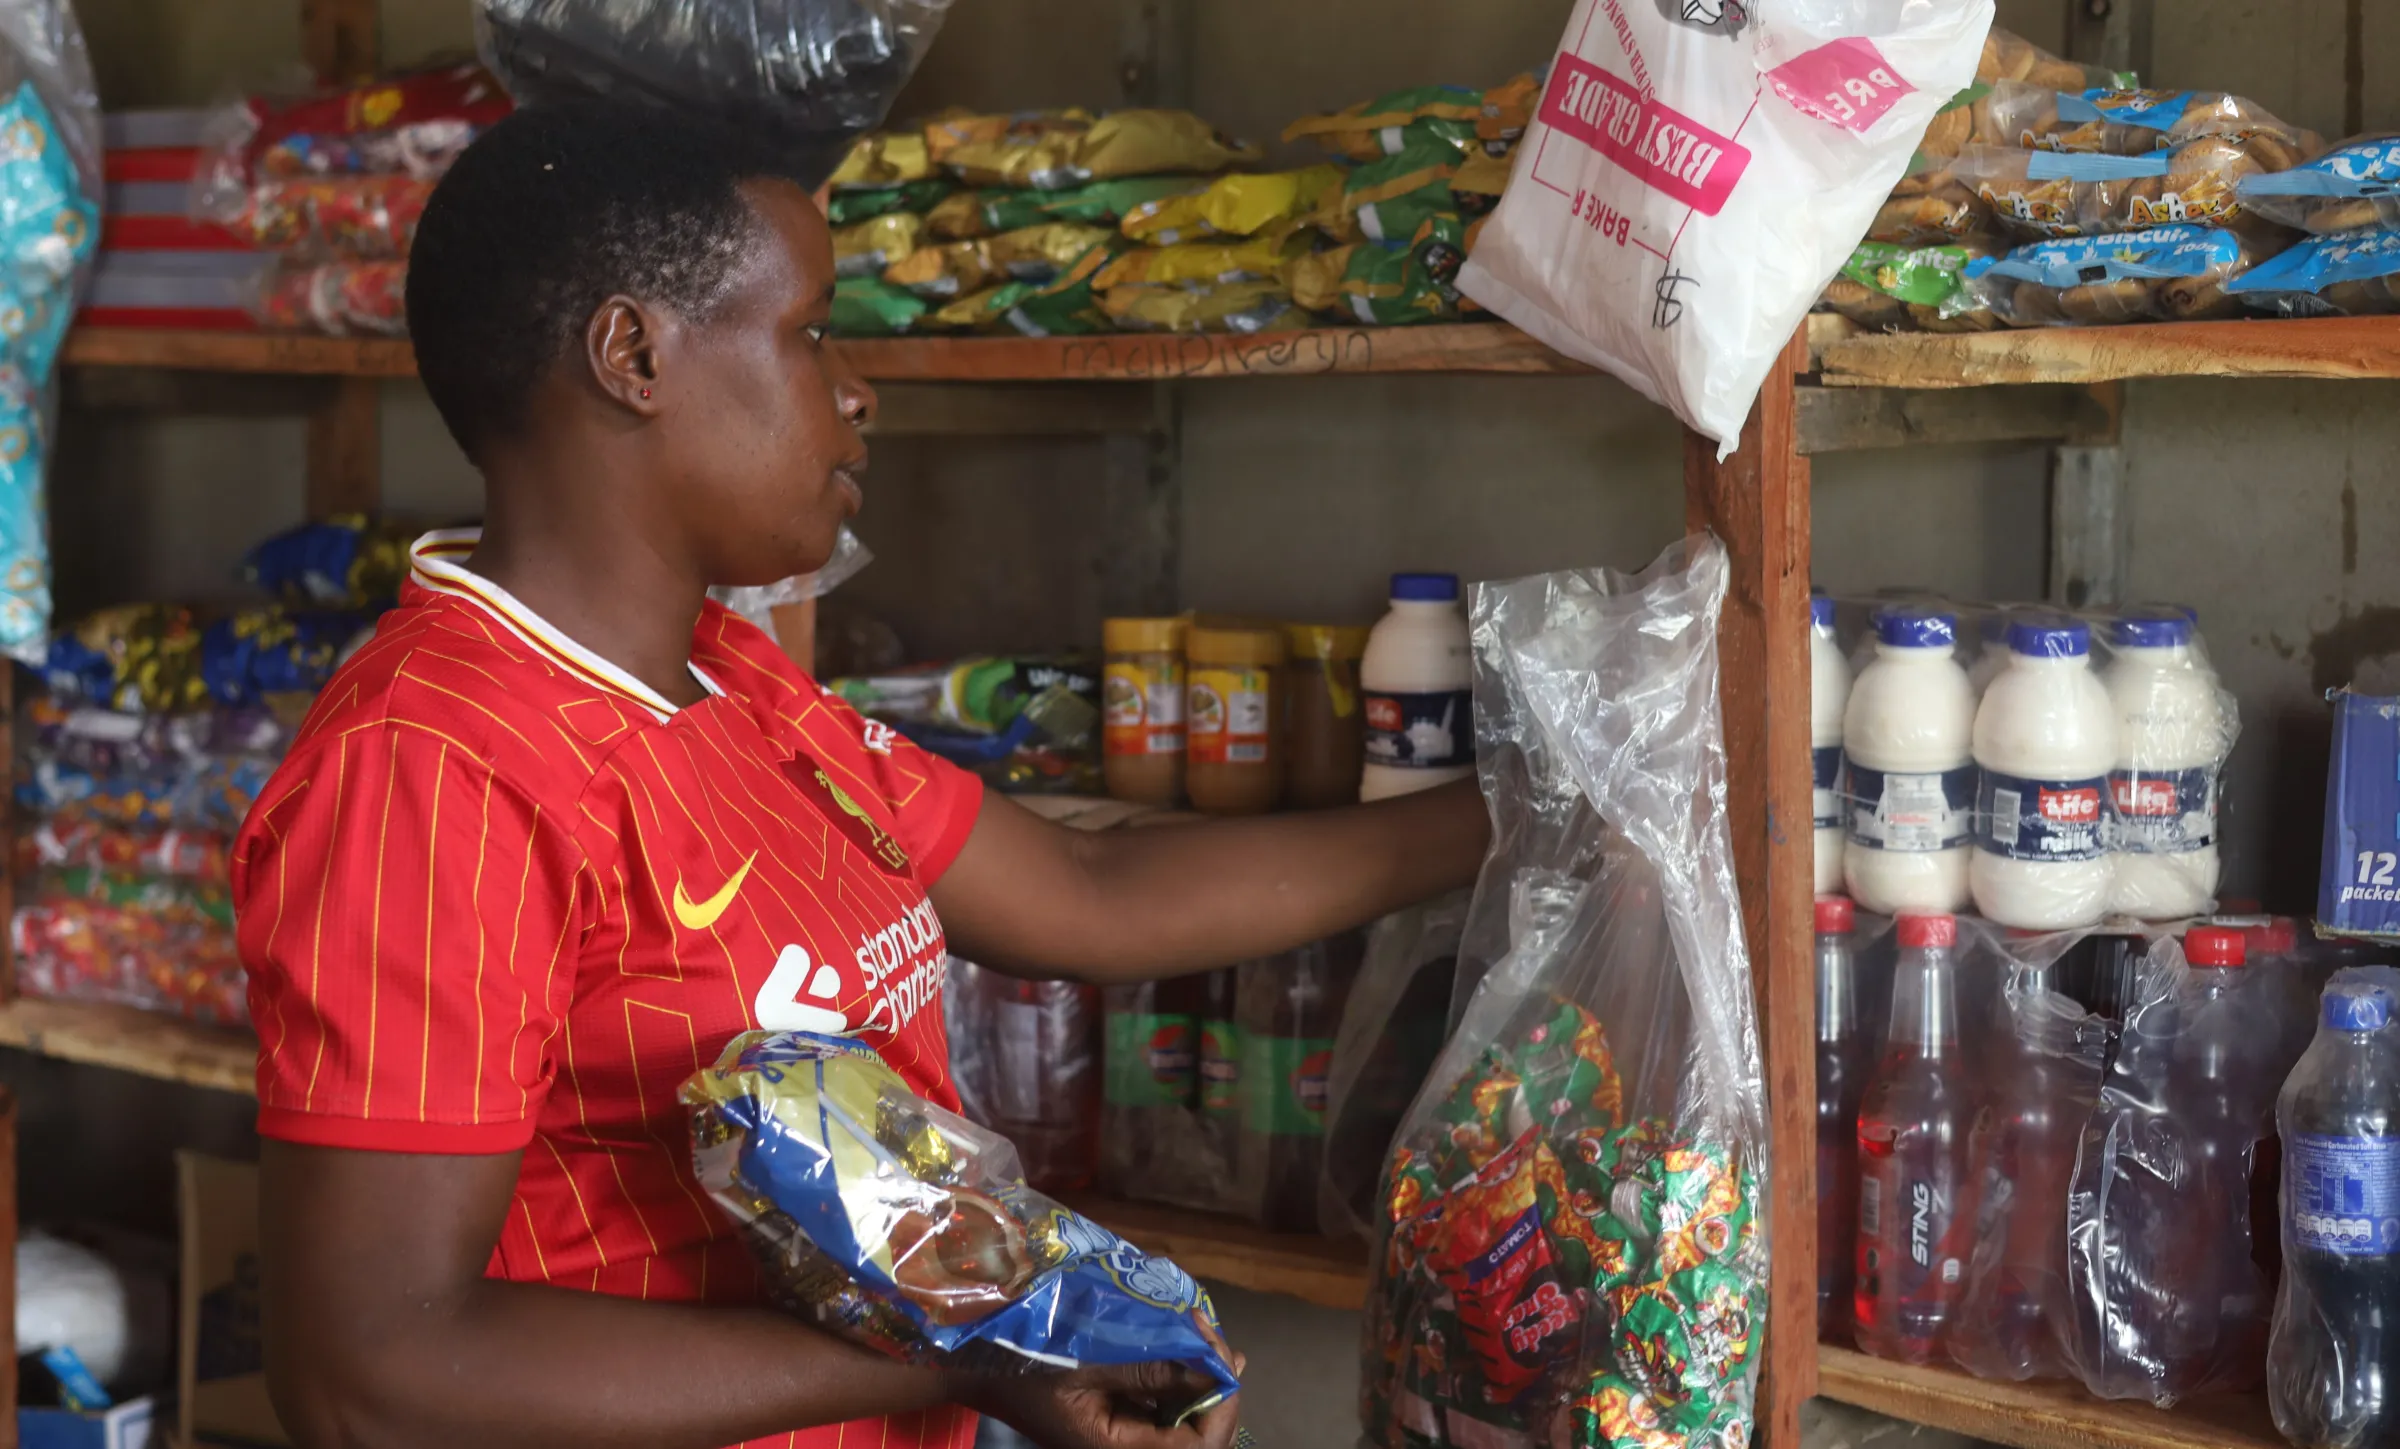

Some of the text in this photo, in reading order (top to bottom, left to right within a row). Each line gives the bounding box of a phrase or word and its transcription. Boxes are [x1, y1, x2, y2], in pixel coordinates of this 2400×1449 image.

[1630, 50, 1656, 104] SUPER
[1559, 69, 1723, 190] BEST GRADE
[2043, 794, 2095, 816] Life
[2358, 851, 2397, 885] 12
[856, 896, 943, 991] standar
[861, 948, 947, 1034] chartere
[1488, 1221, 1532, 1264] TOMATO
[1912, 1183, 1929, 1266] STING
